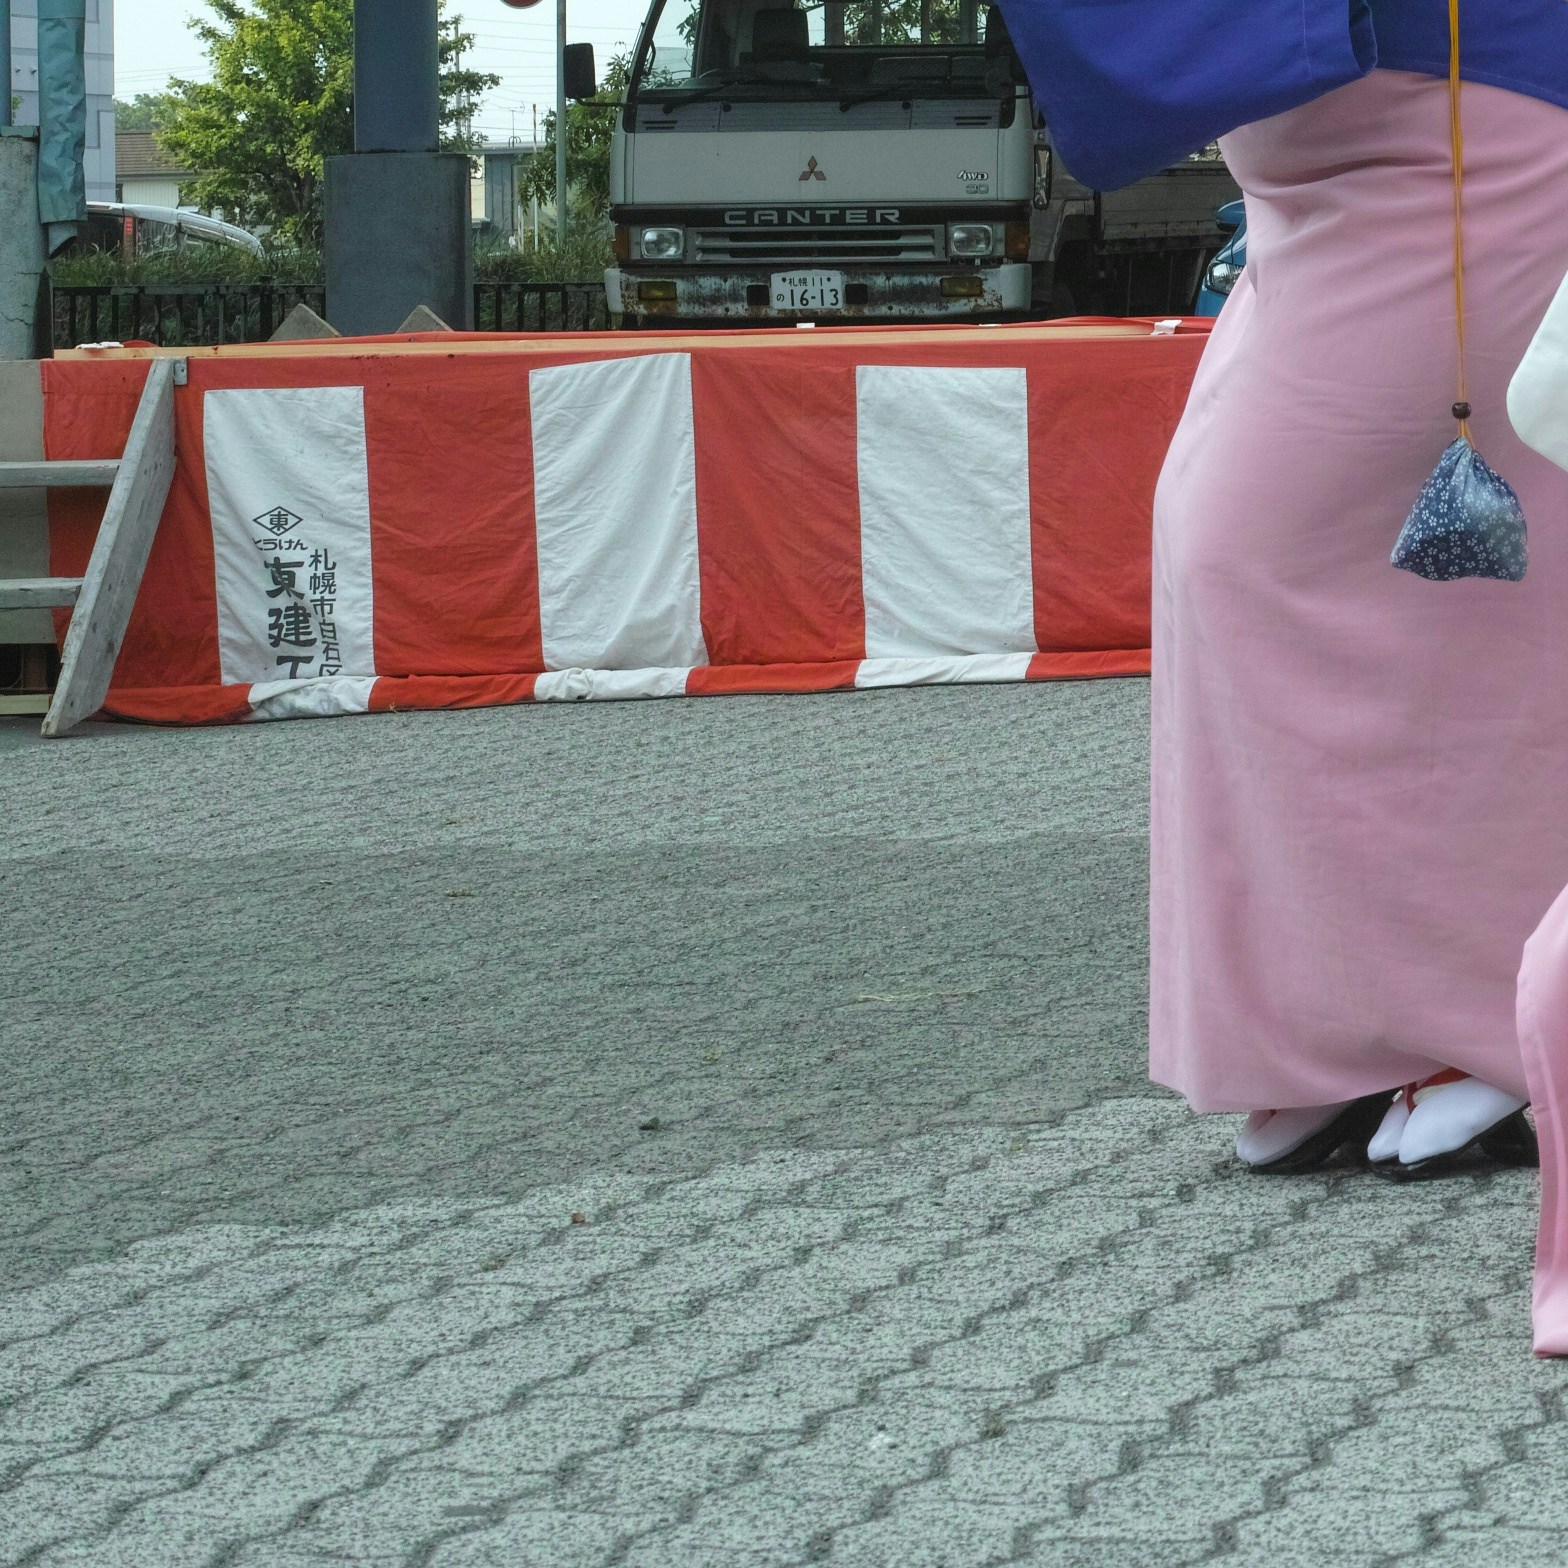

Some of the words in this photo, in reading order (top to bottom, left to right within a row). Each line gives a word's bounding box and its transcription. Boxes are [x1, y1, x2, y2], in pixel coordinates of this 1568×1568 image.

[957, 170, 989, 181] 4WD
[724, 209, 901, 225] CANTER
[790, 289, 839, 307] 16-13
[269, 511, 289, 531] 東
